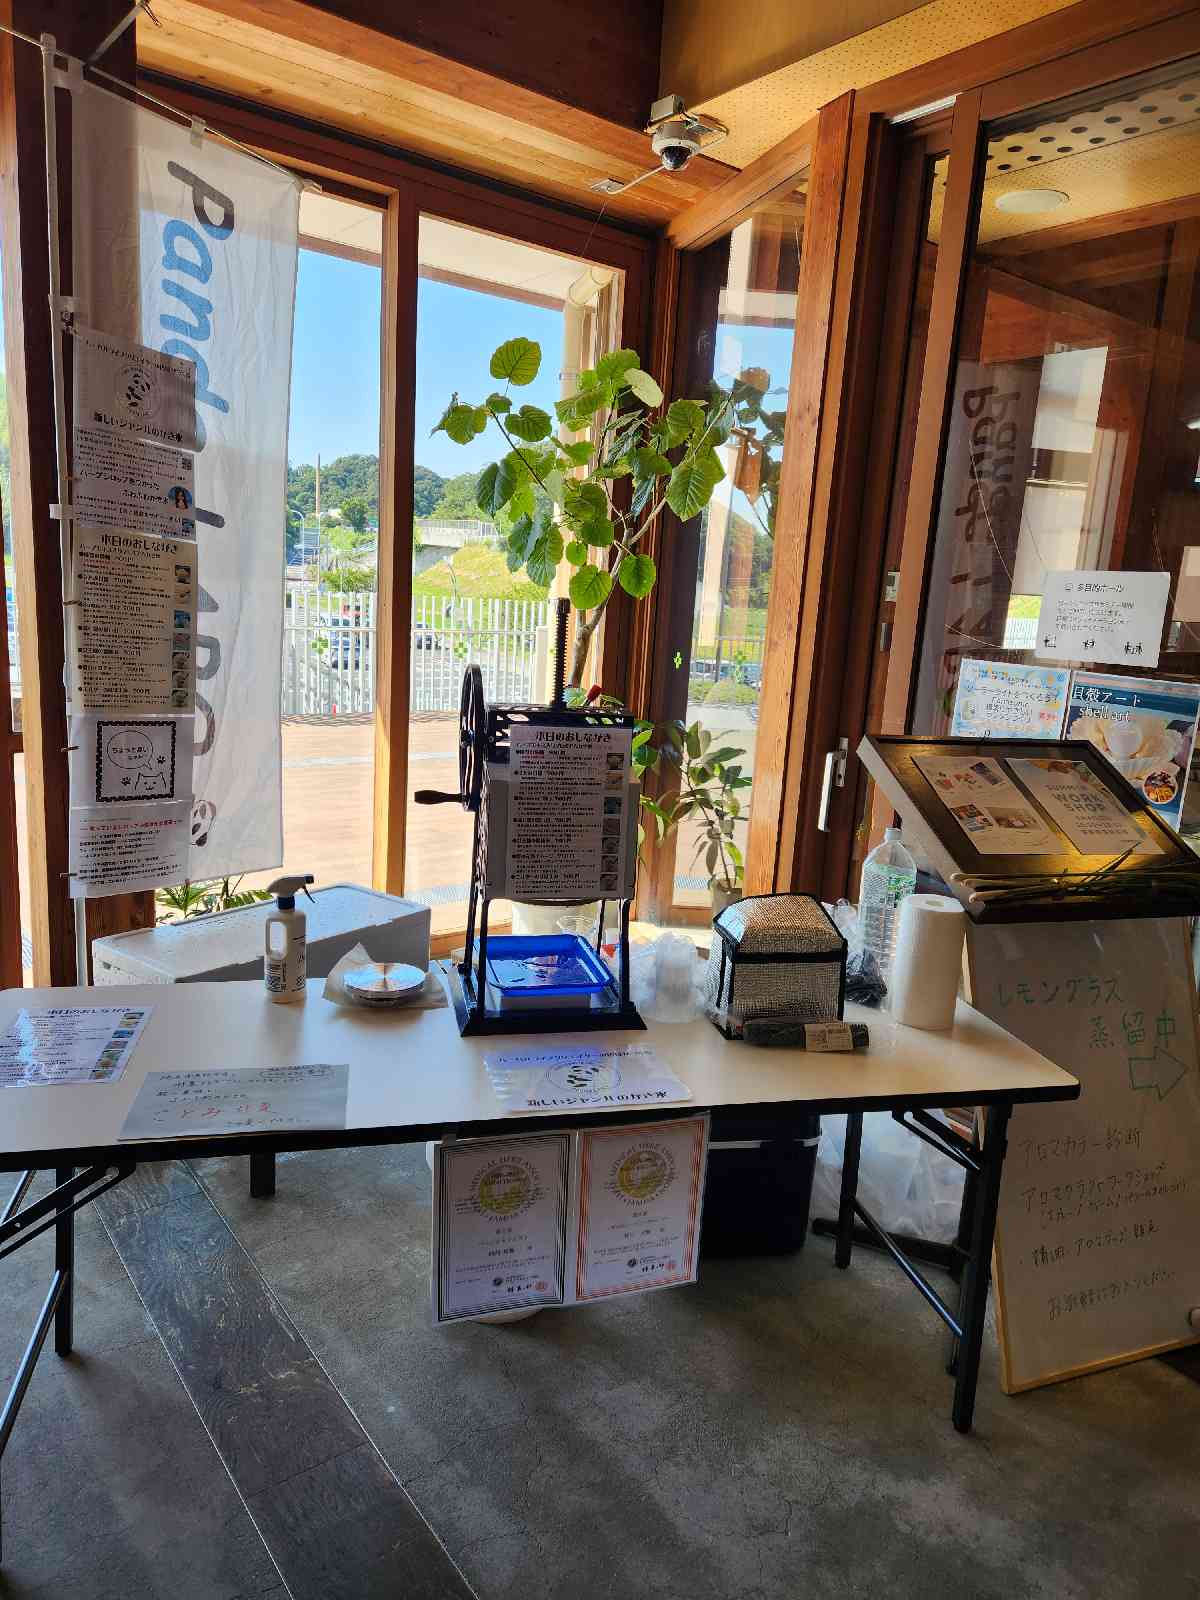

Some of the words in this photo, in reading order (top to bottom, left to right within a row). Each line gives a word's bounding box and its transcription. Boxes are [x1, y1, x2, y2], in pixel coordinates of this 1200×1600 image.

[159, 160, 235, 452] Pand
[1073, 686, 1141, 708] 貝殻アート
[1079, 706, 1109, 720] shell
[998, 975, 1125, 1008] レモングラス
